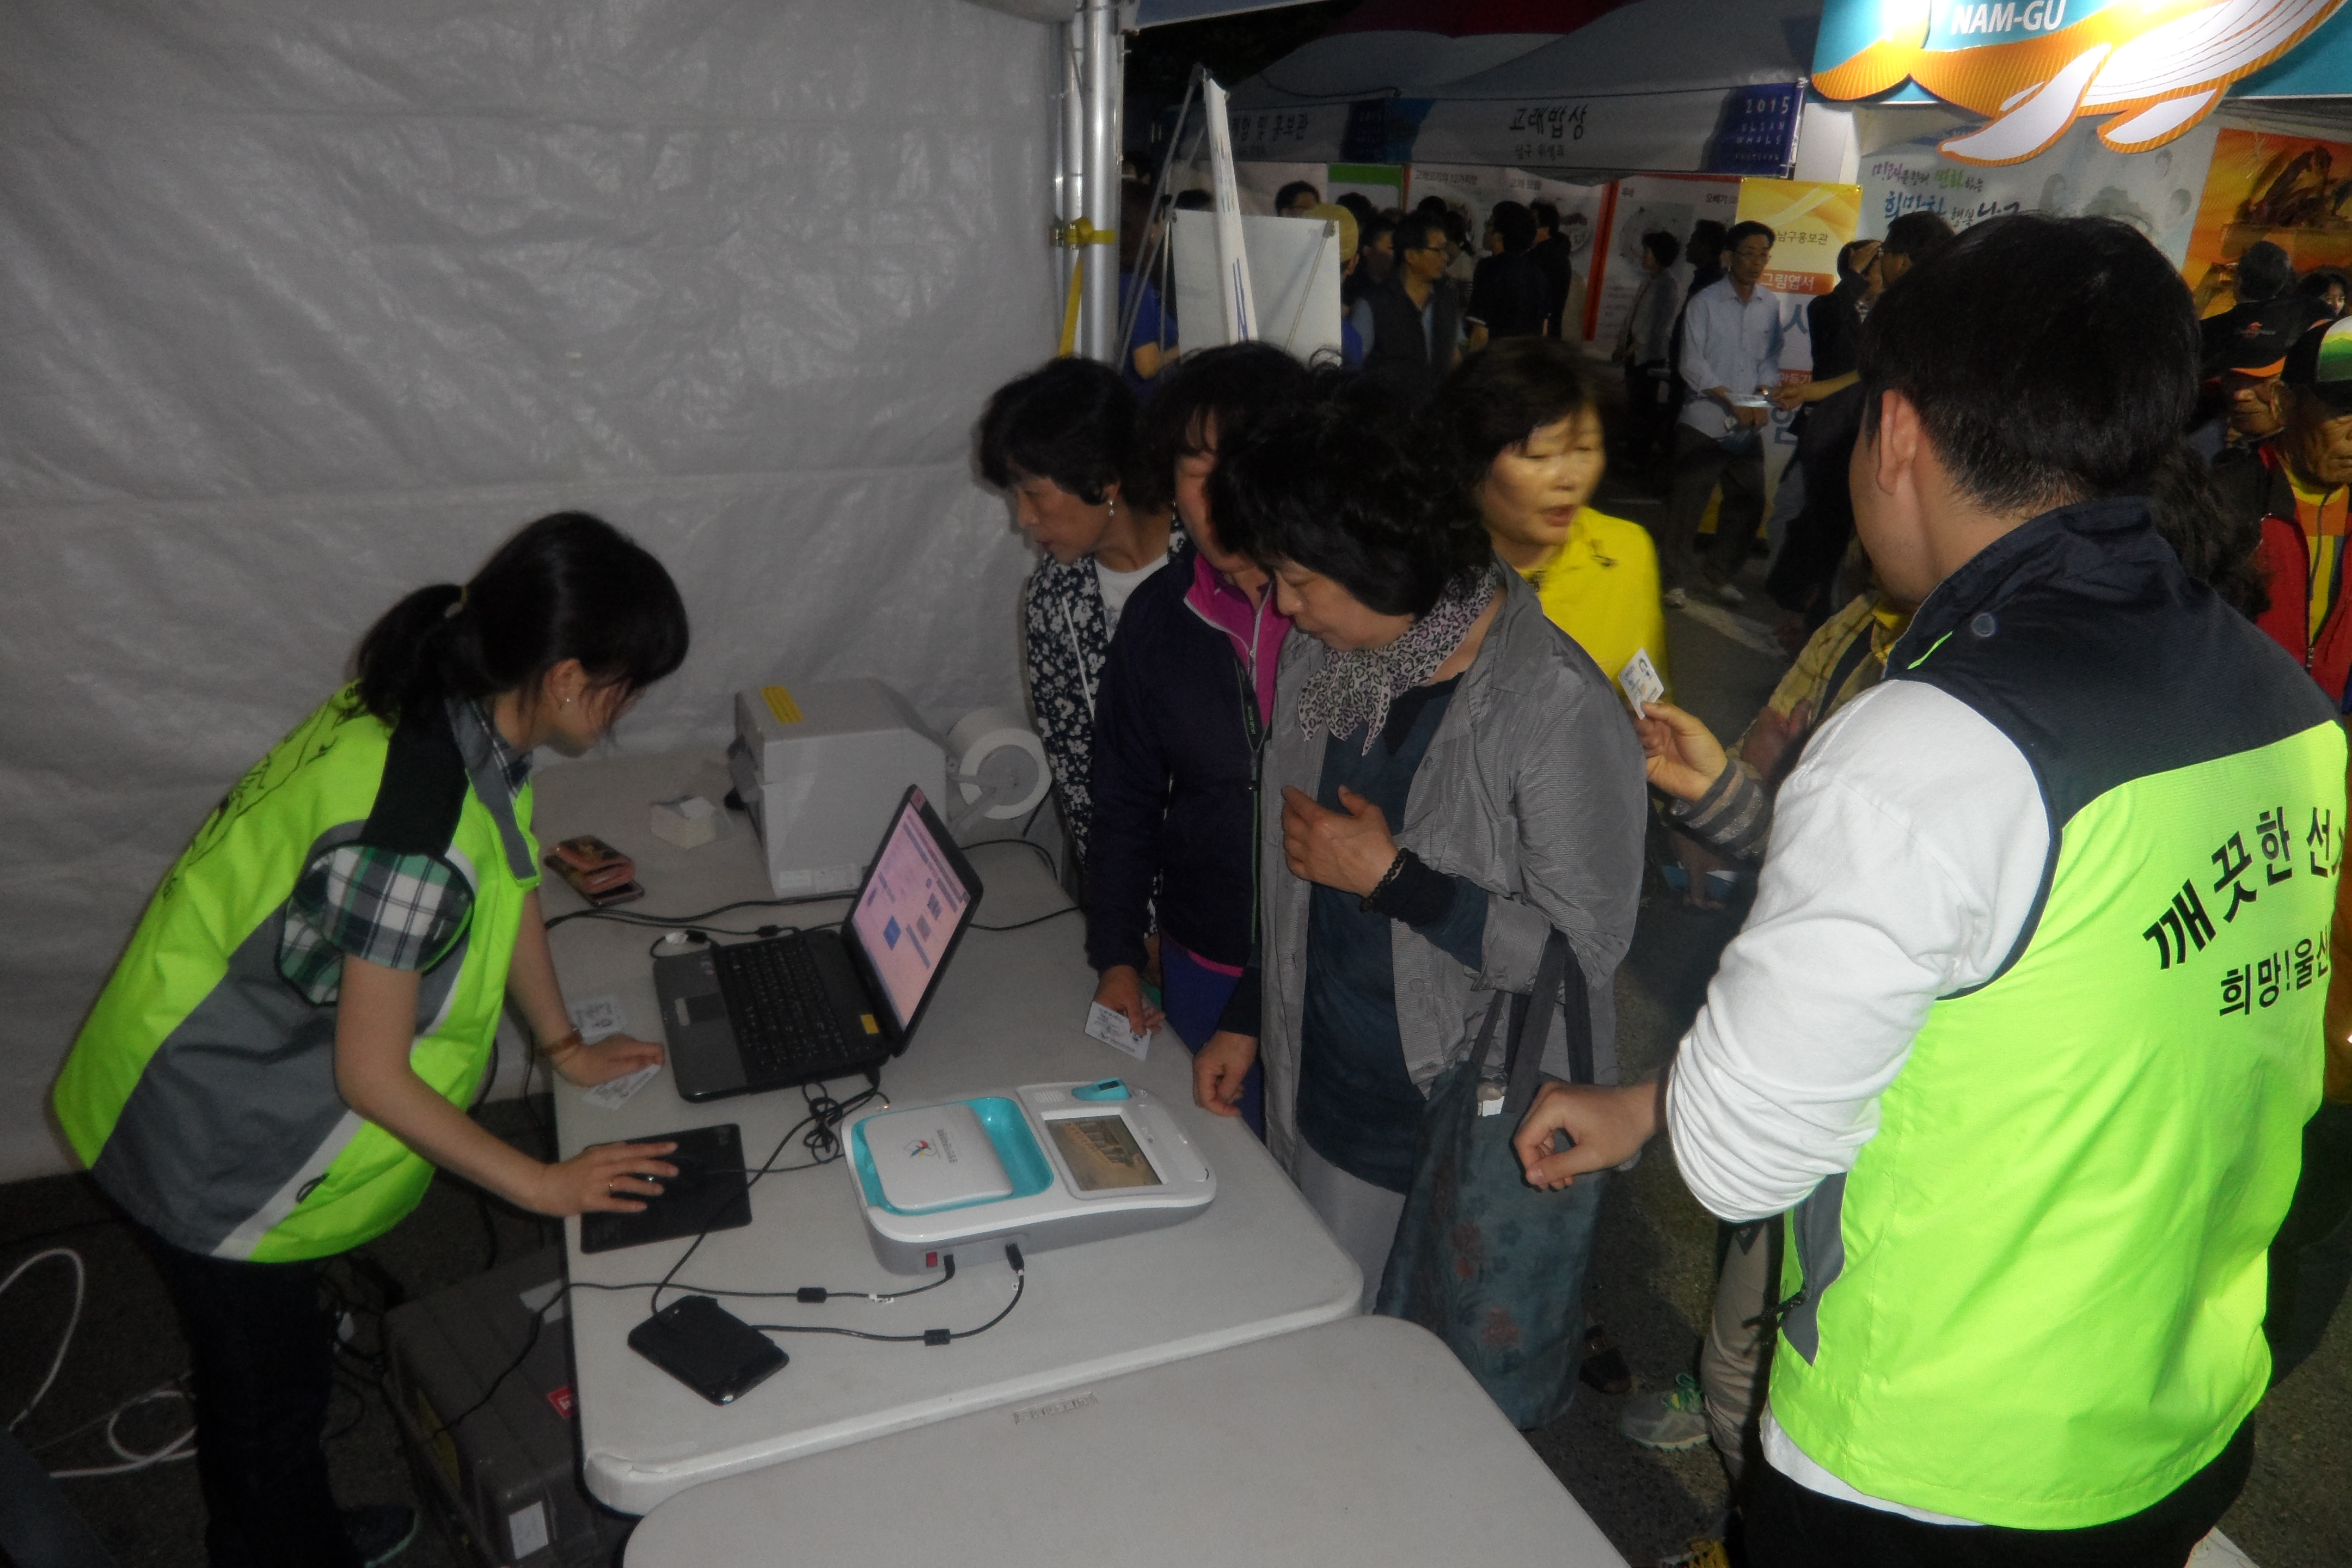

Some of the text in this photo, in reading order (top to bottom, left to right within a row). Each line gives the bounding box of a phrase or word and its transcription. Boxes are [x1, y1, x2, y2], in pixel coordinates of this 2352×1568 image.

[1951, 0, 2066, 34] NAM-GU
[1745, 95, 1791, 115] 2015
[1509, 104, 1588, 140] 고래밥상
[1778, 231, 1829, 245] 남구홍보관
[1761, 273, 1815, 291] 그림엽서
[2142, 806, 2293, 971] 깨끗한
